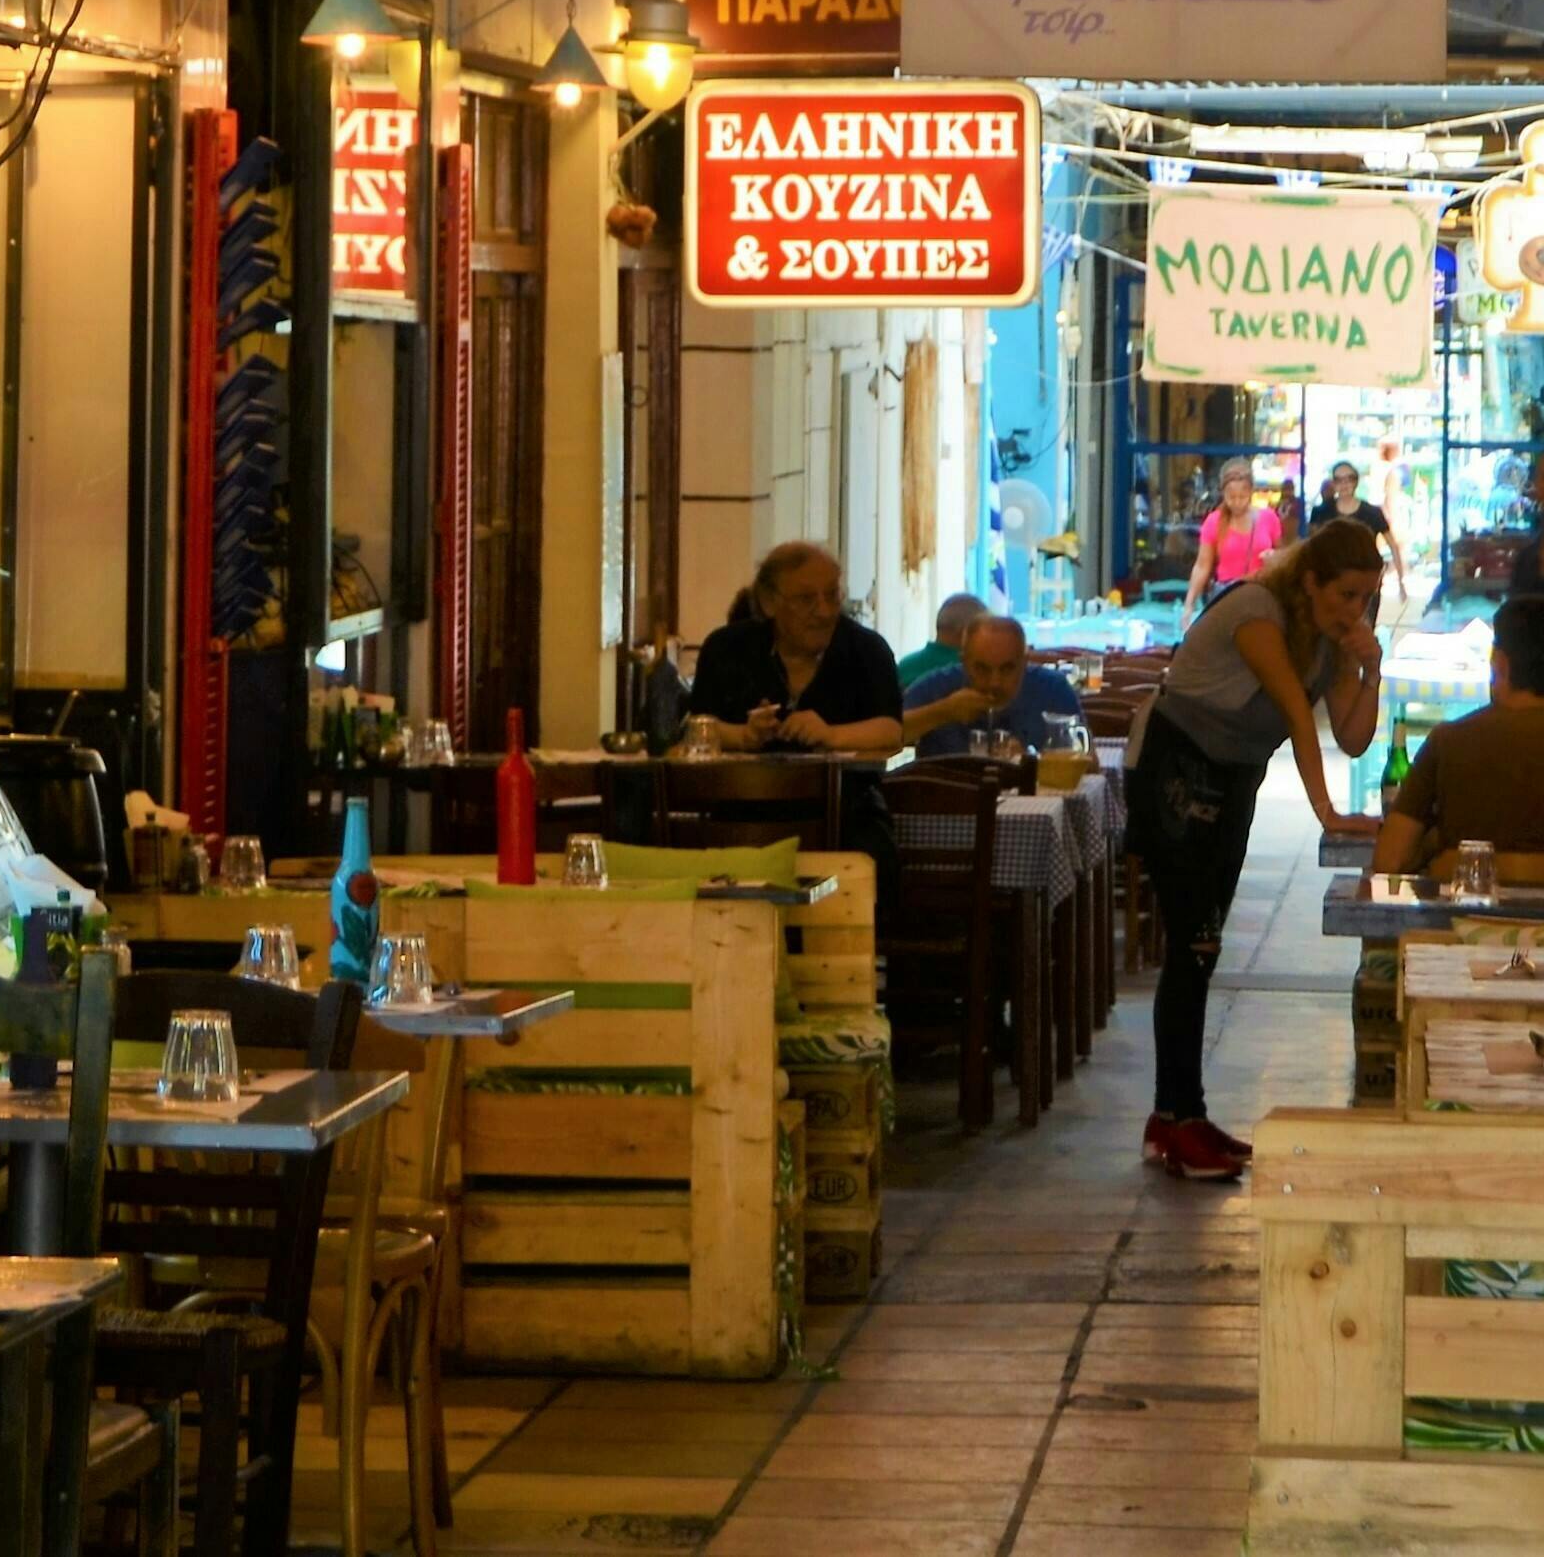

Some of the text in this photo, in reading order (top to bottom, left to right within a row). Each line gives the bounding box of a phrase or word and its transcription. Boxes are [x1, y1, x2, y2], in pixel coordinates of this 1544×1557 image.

[706, 112, 1019, 160] ΕΛΛΗΝΙΚΗ
[729, 174, 991, 221] ΚΟΥΖΙΝΑ
[726, 238, 990, 281] & ΣΟΥΠΕΣ
[1209, 307, 1369, 352] TAVERNA
